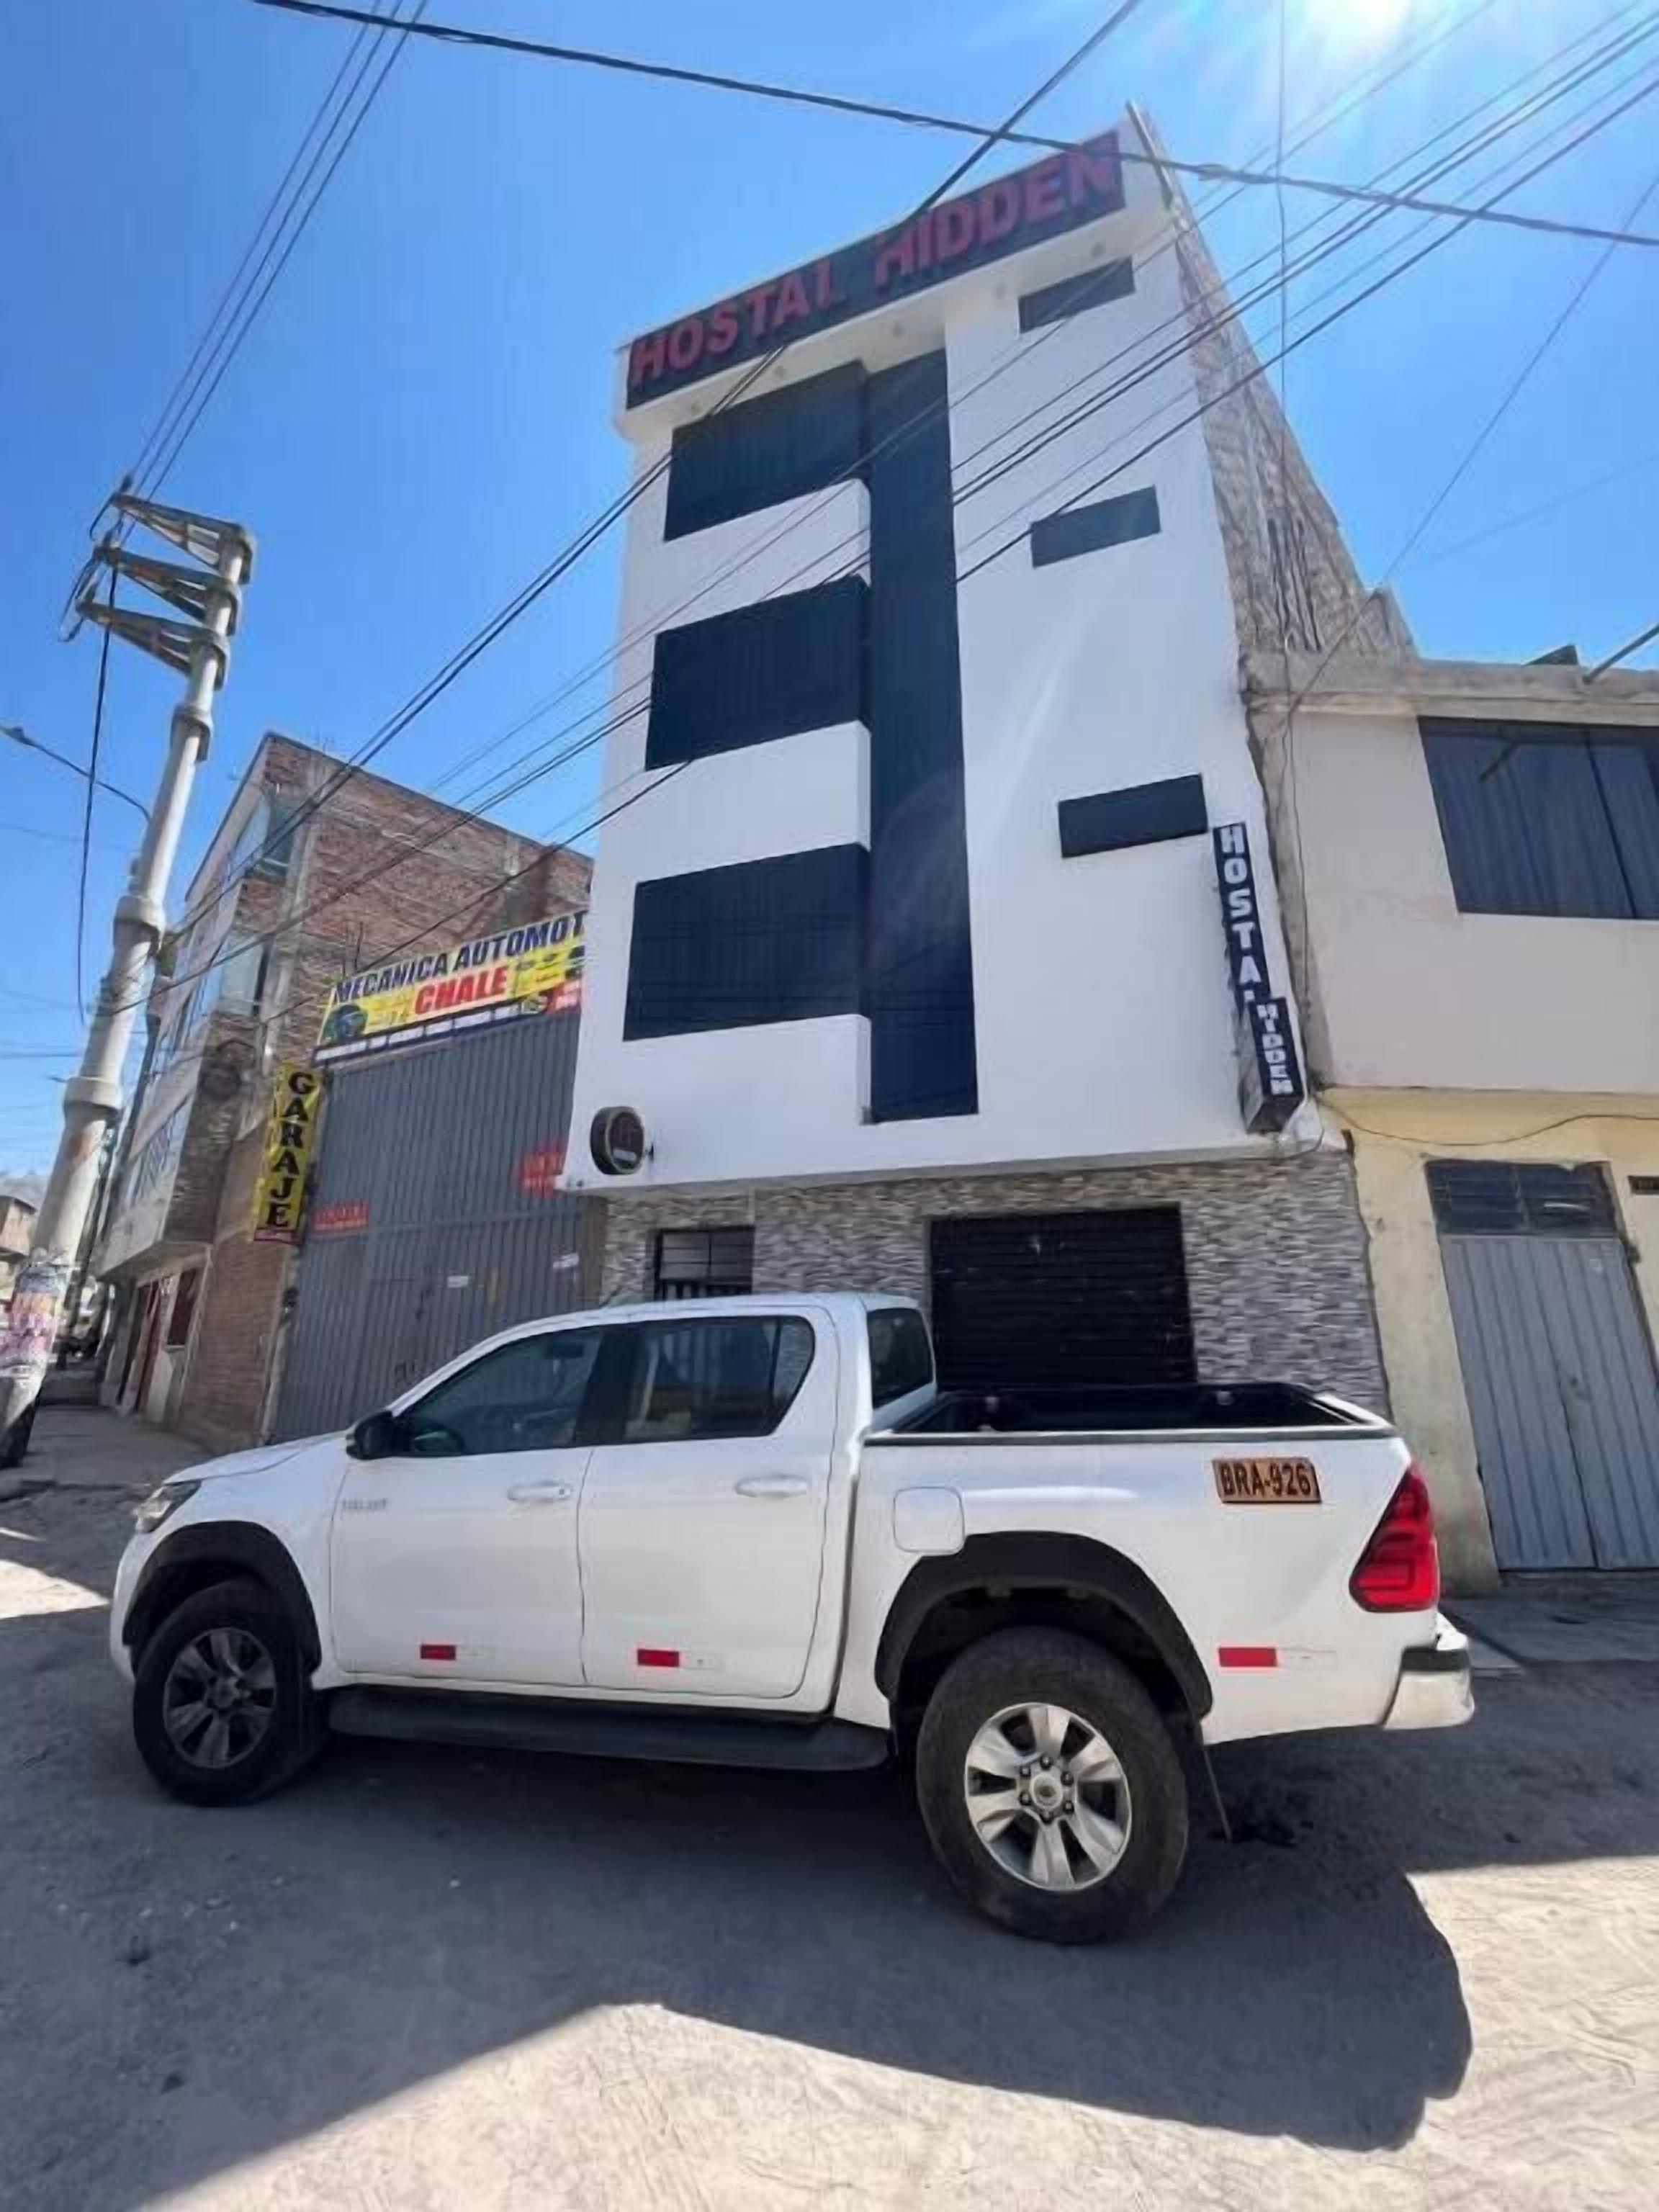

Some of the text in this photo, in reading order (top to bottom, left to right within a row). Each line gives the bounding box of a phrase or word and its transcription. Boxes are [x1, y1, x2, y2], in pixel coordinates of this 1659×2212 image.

[632, 257, 847, 383] HOSTAL
[336, 953, 448, 1002] MECANICA
[415, 965, 509, 1015] CHALE
[1219, 1462, 1311, 1496] BRA-926
